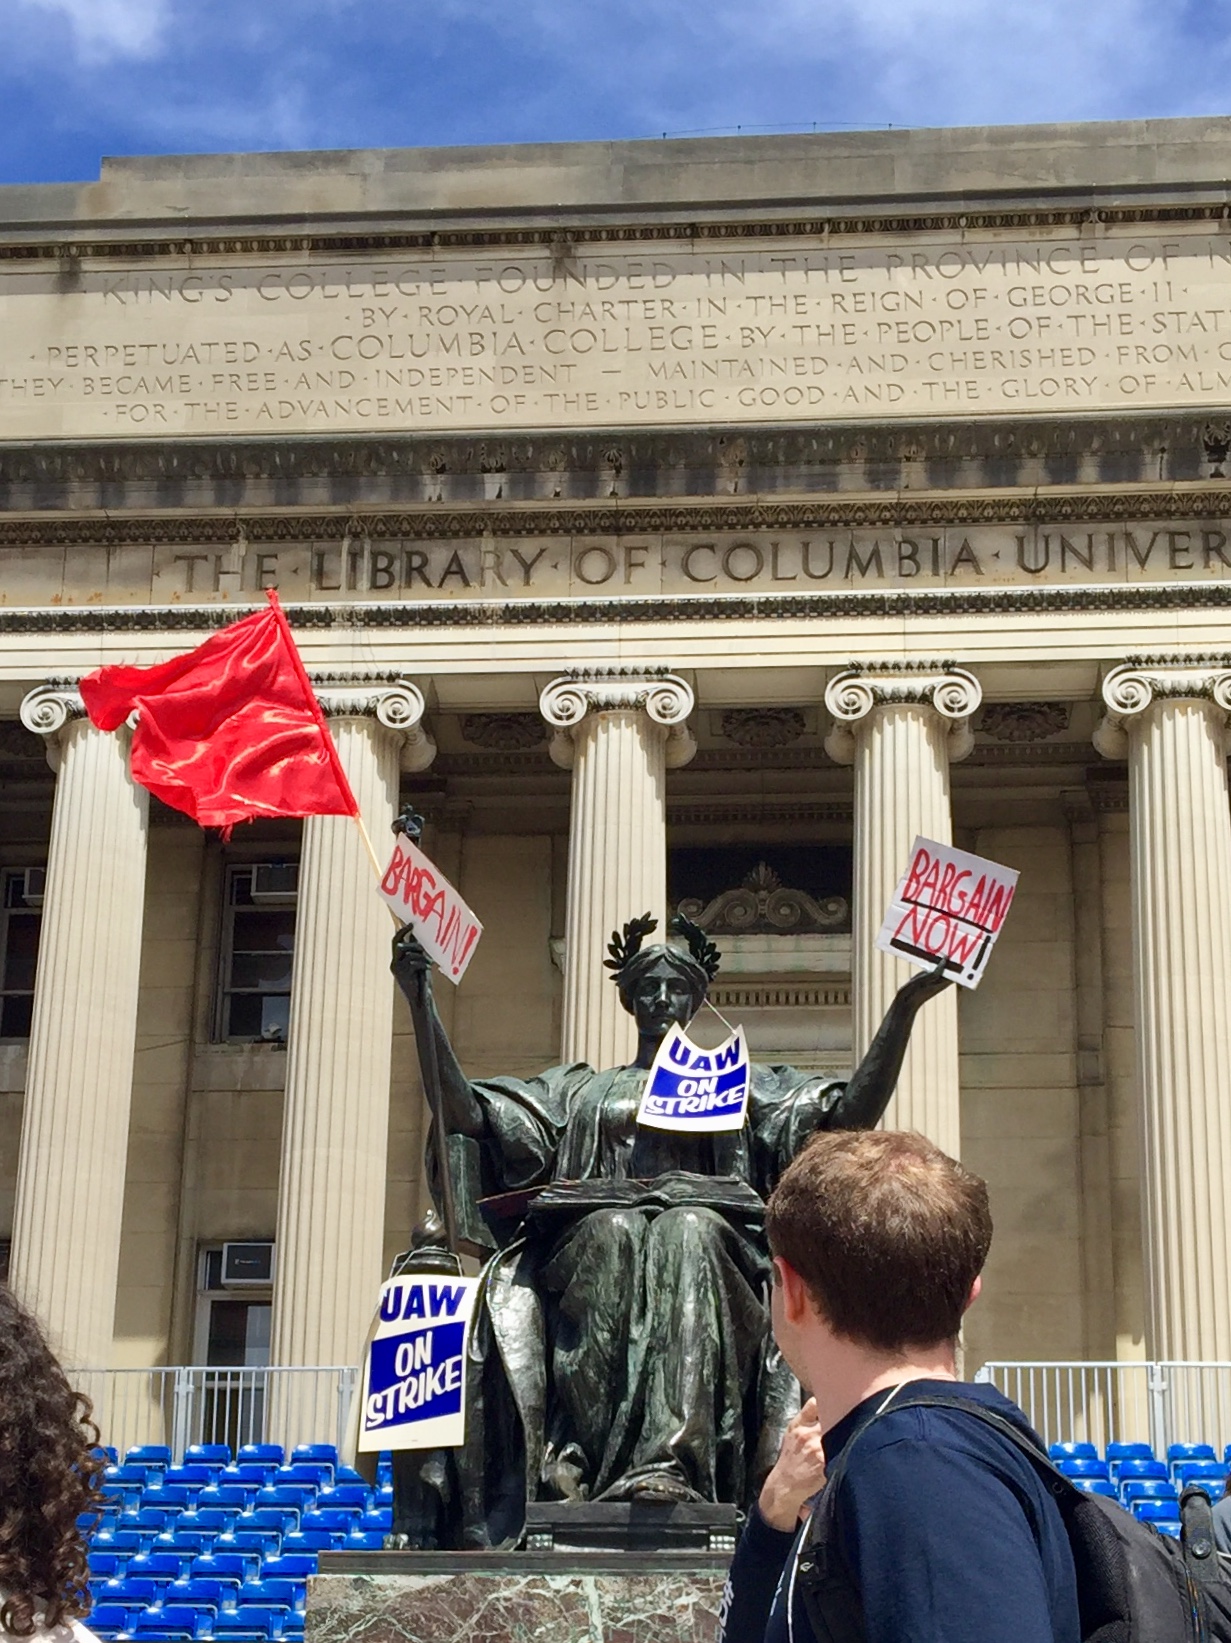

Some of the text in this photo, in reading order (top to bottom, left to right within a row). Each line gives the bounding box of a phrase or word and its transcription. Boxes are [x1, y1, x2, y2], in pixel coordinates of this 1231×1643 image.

[102, 273, 233, 305] KING'S
[256, 268, 448, 301] COLLEGE
[474, 262, 677, 293] FOUNDED
[705, 259, 747, 288] IN
[770, 255, 858, 284] THE
[885, 247, 1100, 281] PROVINCE
[1123, 243, 1180, 272] OF
[362, 281, 1173, 328] BY ROYAL CHARTER IN THE REIGN OF GEORGE II
[47, 310, 1231, 368] PERPETUATED AS COLUMBIA COLLEGE BY THE PEOPLE OF THE STAT
[83, 374, 192, 397] BECAME
[212, 372, 276, 393] FREE
[294, 369, 355, 390] AND
[375, 364, 577, 388] INDEPENDENT
[648, 356, 828, 380] MAINTAINED
[846, 353, 909, 374] AND
[928, 347, 1095, 372] CHERISHED
[1116, 344, 1198, 366] FROM
[115, 403, 169, 423] FOR
[184, 401, 239, 421] THE
[256, 395, 473, 420] ADVANCEMENT
[489, 394, 526, 414] OF
[543, 392, 599, 412] THE
[619, 388, 716, 411] PUBLIC
[737, 385, 826, 408] GOOD
[843, 382, 905, 403] AND
[922, 380, 981, 401] THE
[1001, 375, 1099, 399] GLORY
[1119, 374, 1157, 395] OF
[174, 530, 1231, 592] THE LIBRARY OF COLUMBIA UNIVER
[381, 845, 478, 975] BARGAIN!
[902, 848, 1015, 931] BARGAIN
[668, 1036, 740, 1071] UAW
[645, 1083, 746, 1115] STRIKE
[677, 1076, 719, 1097] ON
[379, 1285, 467, 1322] UAW
[395, 1331, 433, 1377] ON
[366, 1355, 462, 1428] STRIKE
